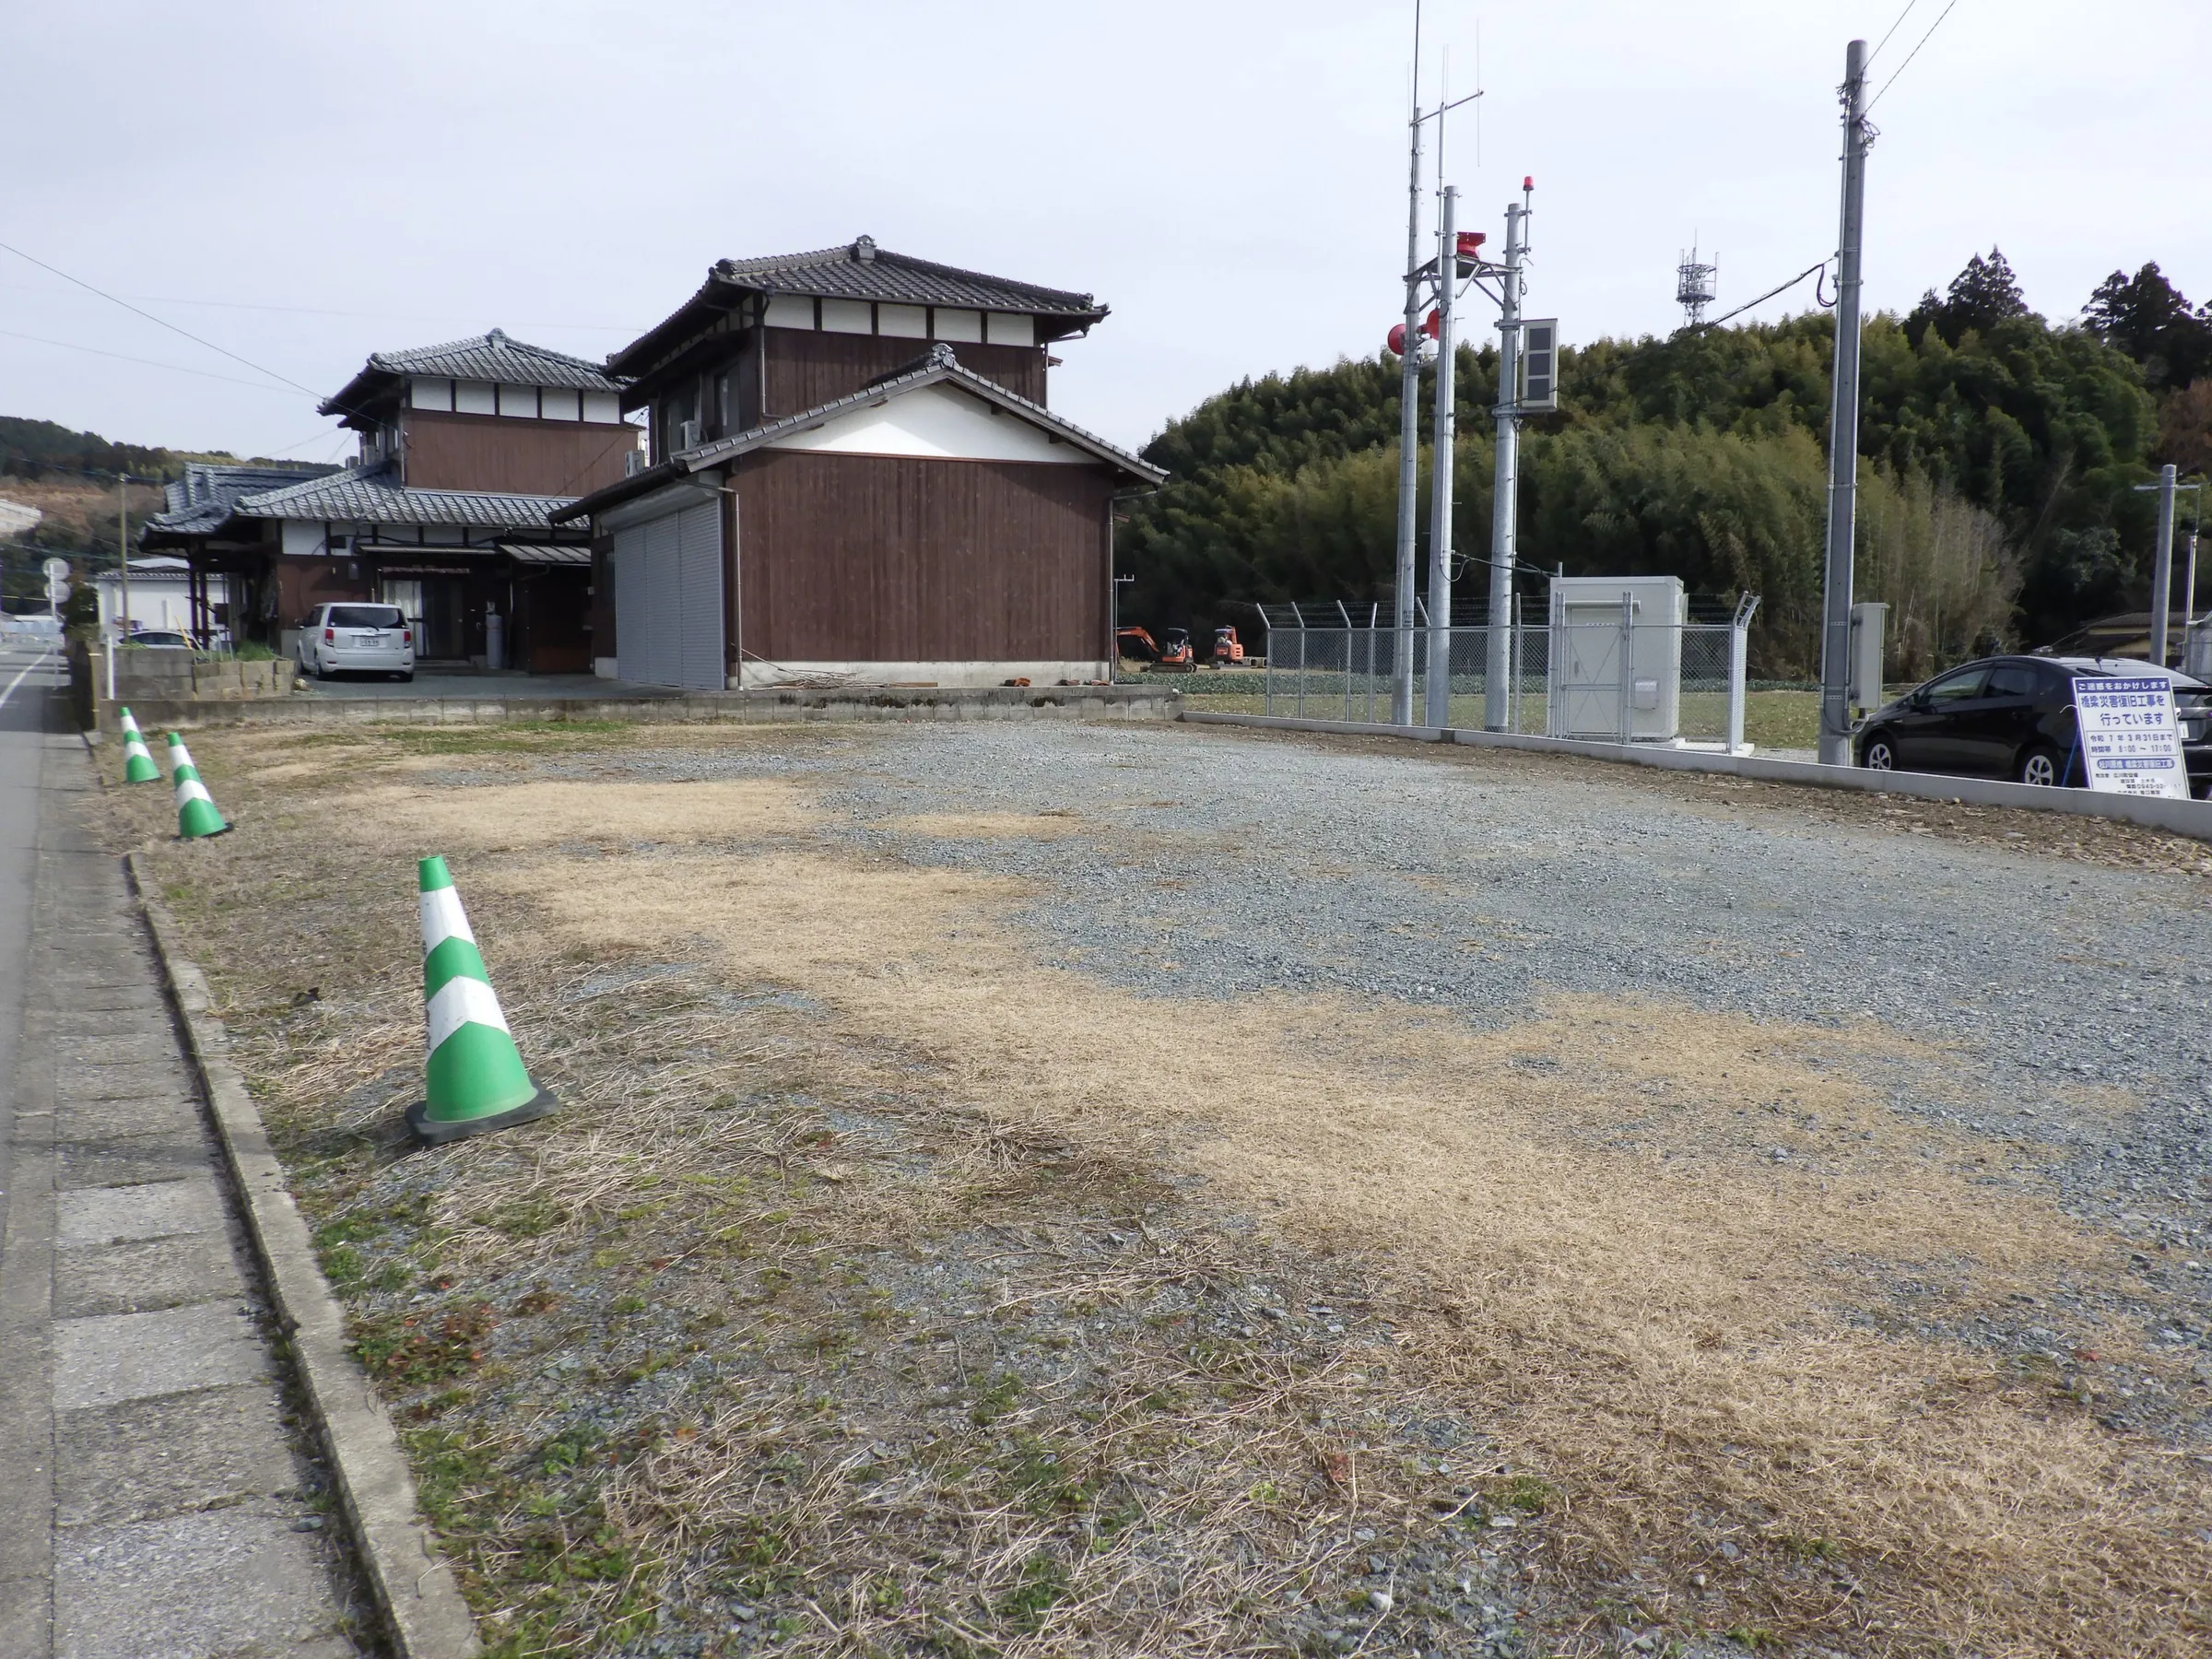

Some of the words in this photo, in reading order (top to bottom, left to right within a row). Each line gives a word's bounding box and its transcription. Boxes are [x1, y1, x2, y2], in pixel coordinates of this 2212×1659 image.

[2078, 681, 2167, 690] ご迷惑をおかけします
[2081, 695, 2165, 708] 橋梁災害復旧工事を
[2100, 712, 2163, 726] 行っています
